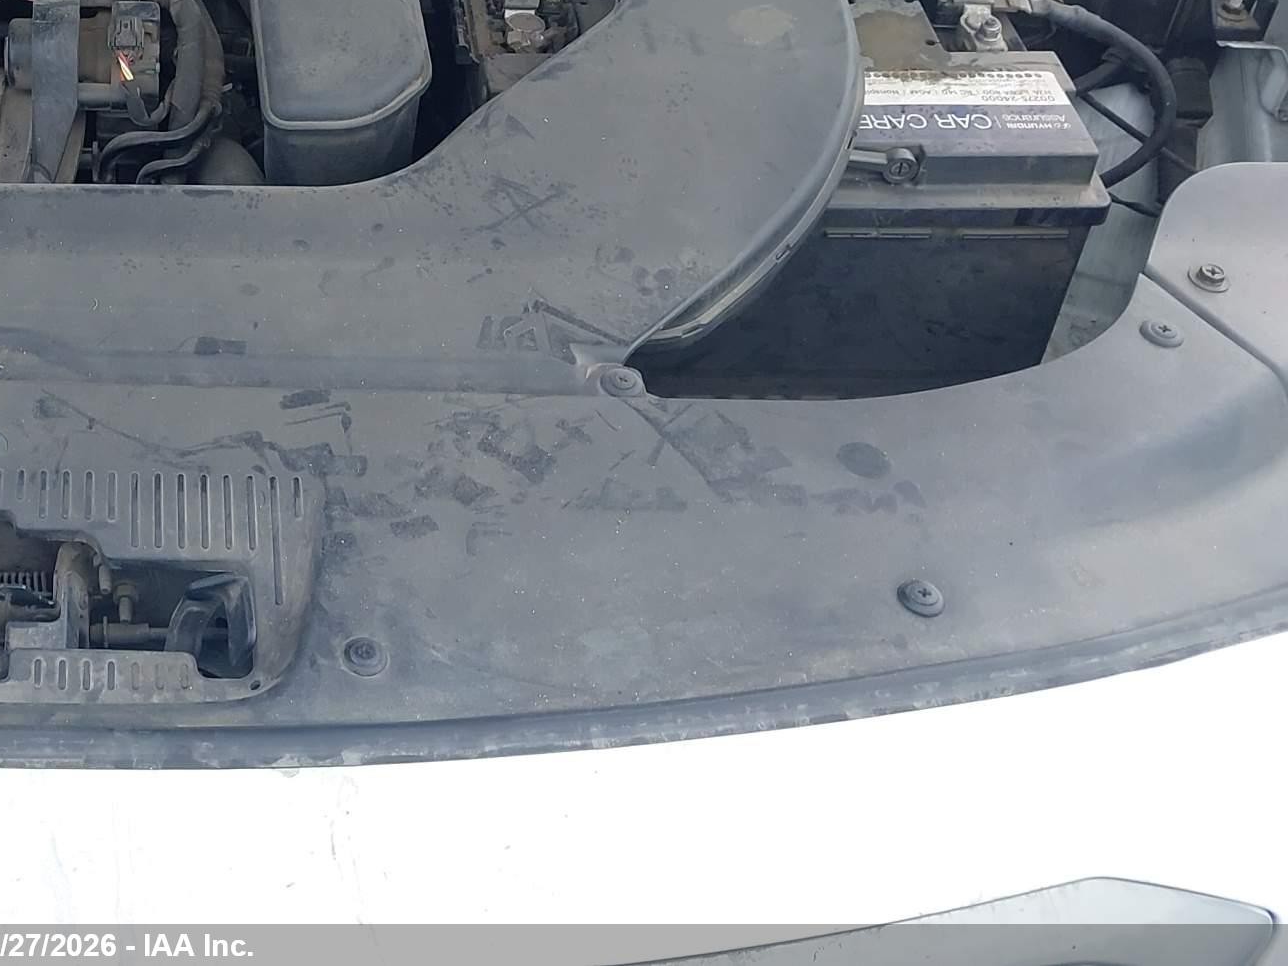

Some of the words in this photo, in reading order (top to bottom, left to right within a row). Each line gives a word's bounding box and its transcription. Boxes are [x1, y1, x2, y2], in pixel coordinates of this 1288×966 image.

[859, 113, 928, 130] CARE
[937, 113, 993, 130] CAR
[1006, 122, 1053, 130] HYUNDAI
